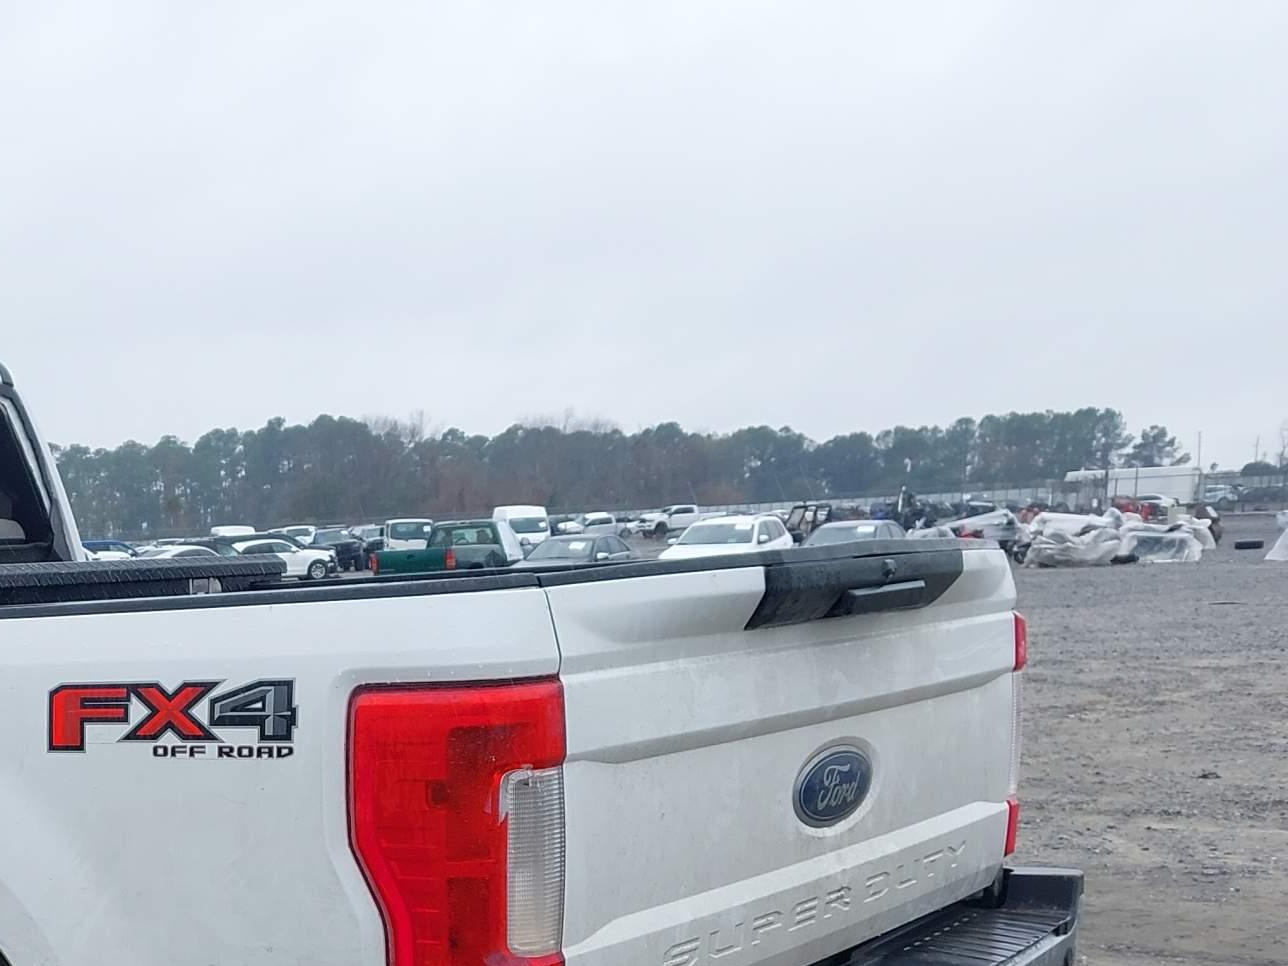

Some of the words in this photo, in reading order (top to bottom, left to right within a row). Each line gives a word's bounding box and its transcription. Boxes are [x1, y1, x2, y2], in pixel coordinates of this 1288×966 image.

[47, 678, 298, 753] FX4
[152, 745, 206, 758] OFF
[217, 745, 294, 759] ROAD
[817, 763, 861, 811] Ford
[863, 840, 967, 903] DUTY
